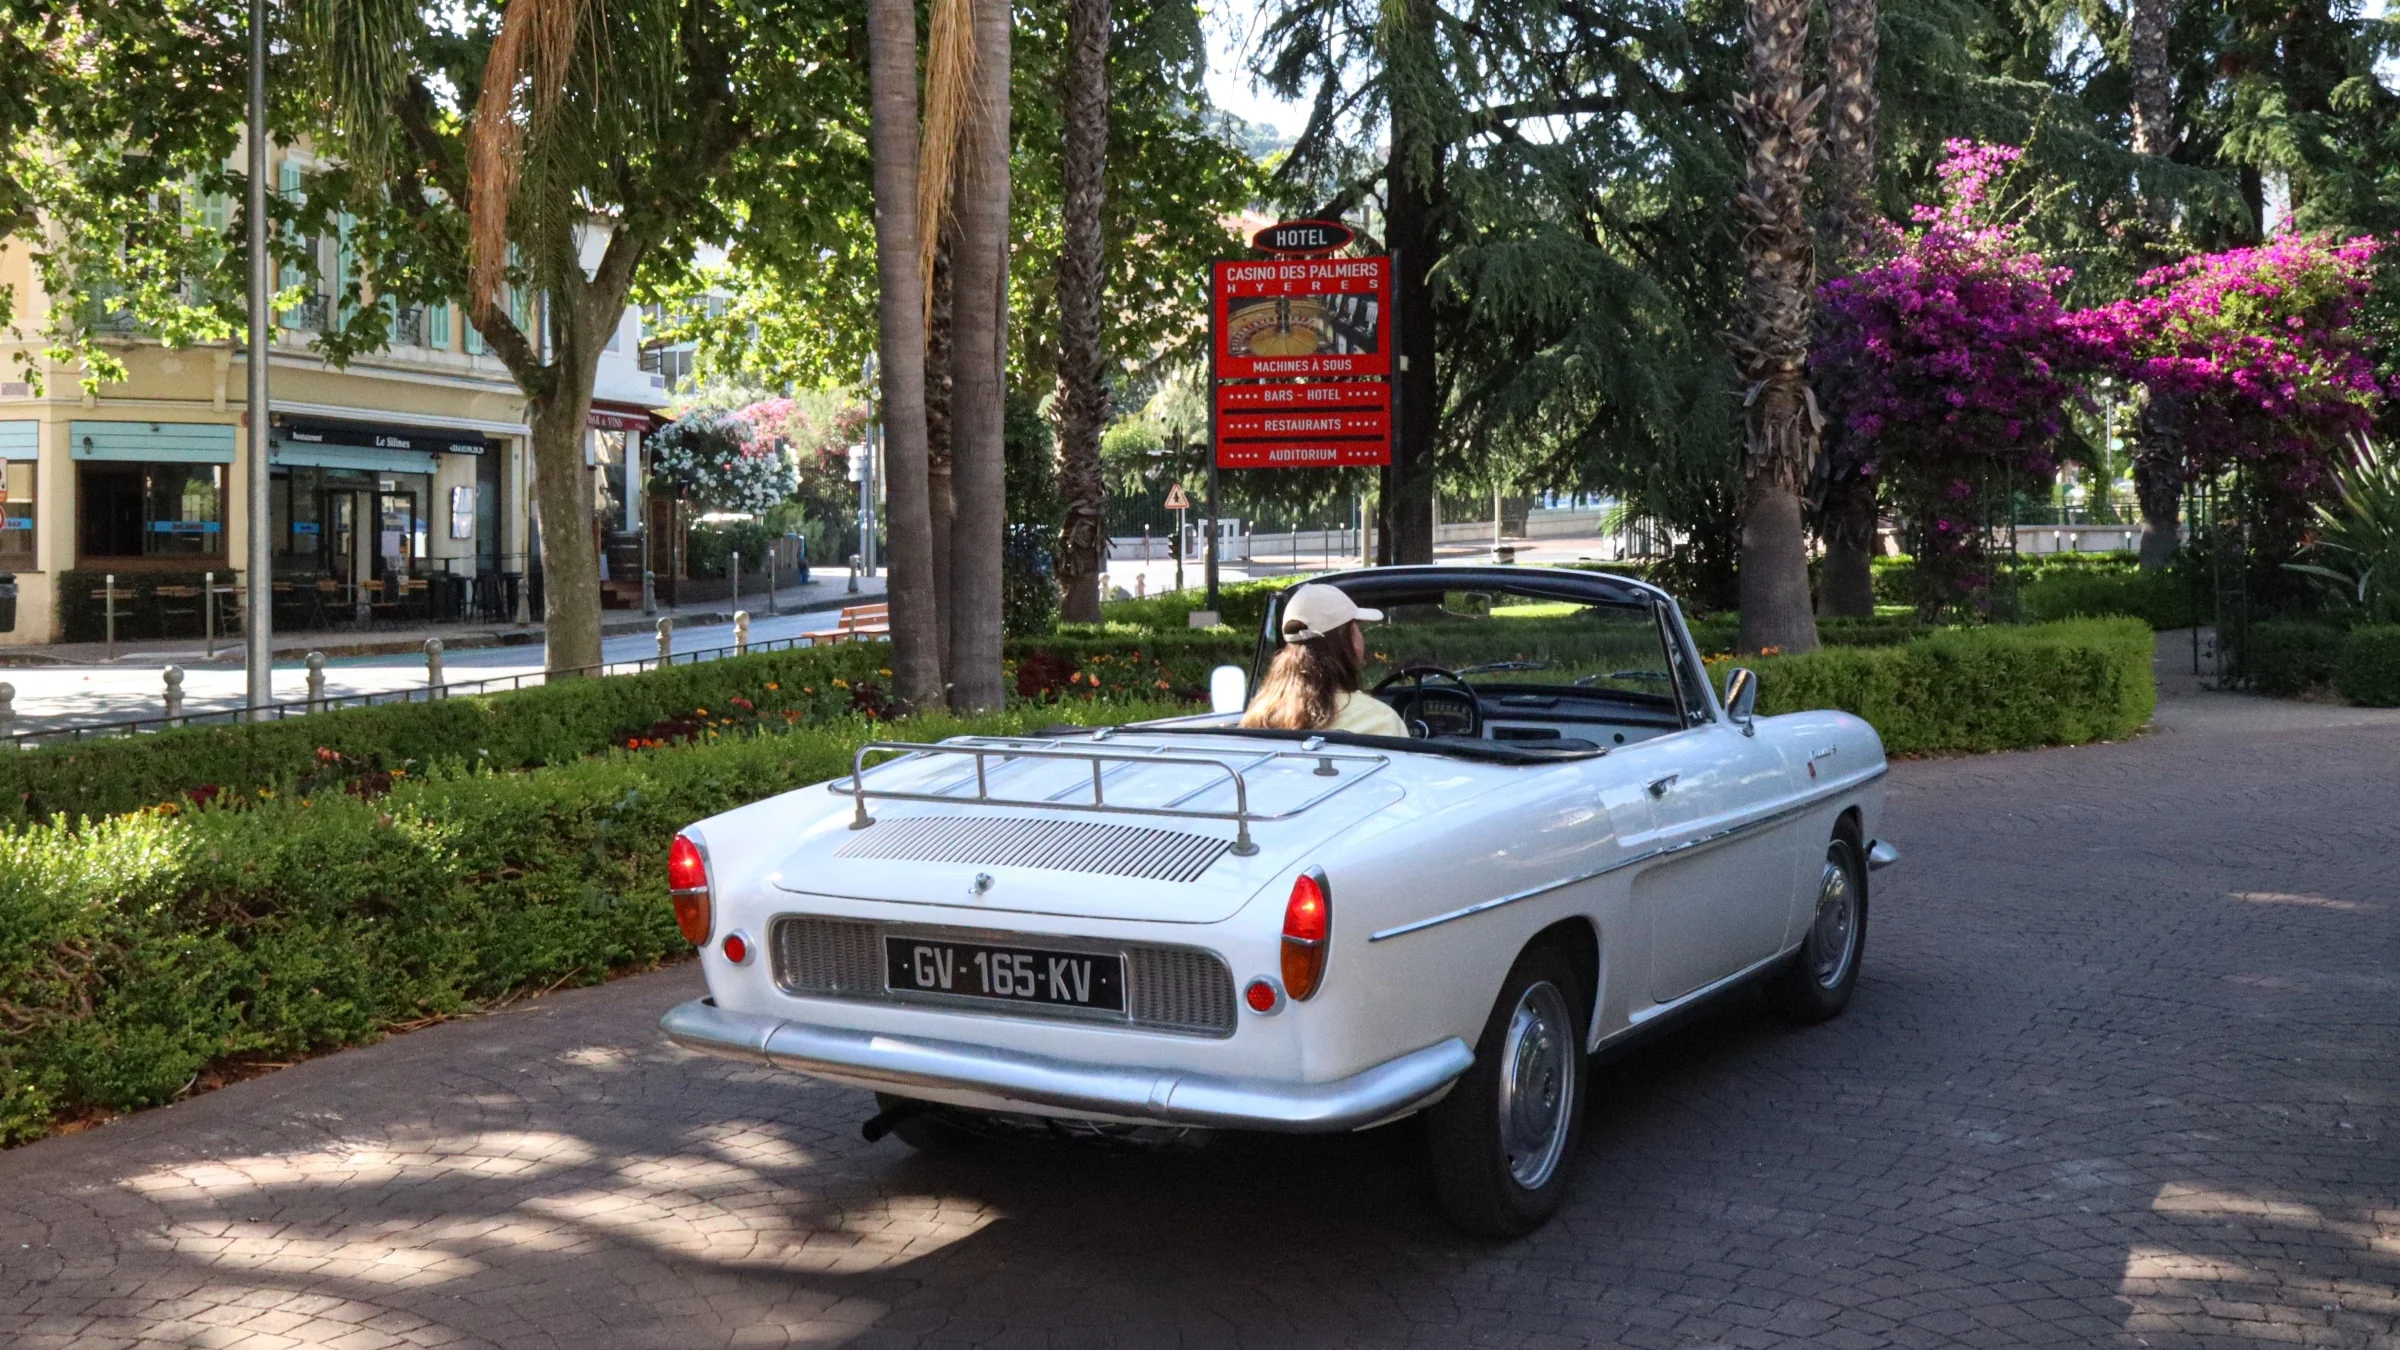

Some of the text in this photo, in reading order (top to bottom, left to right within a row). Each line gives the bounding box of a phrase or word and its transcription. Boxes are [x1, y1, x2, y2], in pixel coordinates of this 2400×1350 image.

[1276, 229, 1328, 247] HOTEL
[1227, 263, 1379, 281] CASINO DES PALMIERS
[1253, 359, 1352, 373] MACHINES À SOUS
[1264, 390, 1293, 401] BARS
[1307, 388, 1341, 401] HOTEL
[1264, 419, 1342, 431] RESTAURANTS
[376, 435, 385, 447] Le
[1268, 449, 1337, 461] AUDITORIUM
[913, 946, 1091, 1002] GV-165-KV
